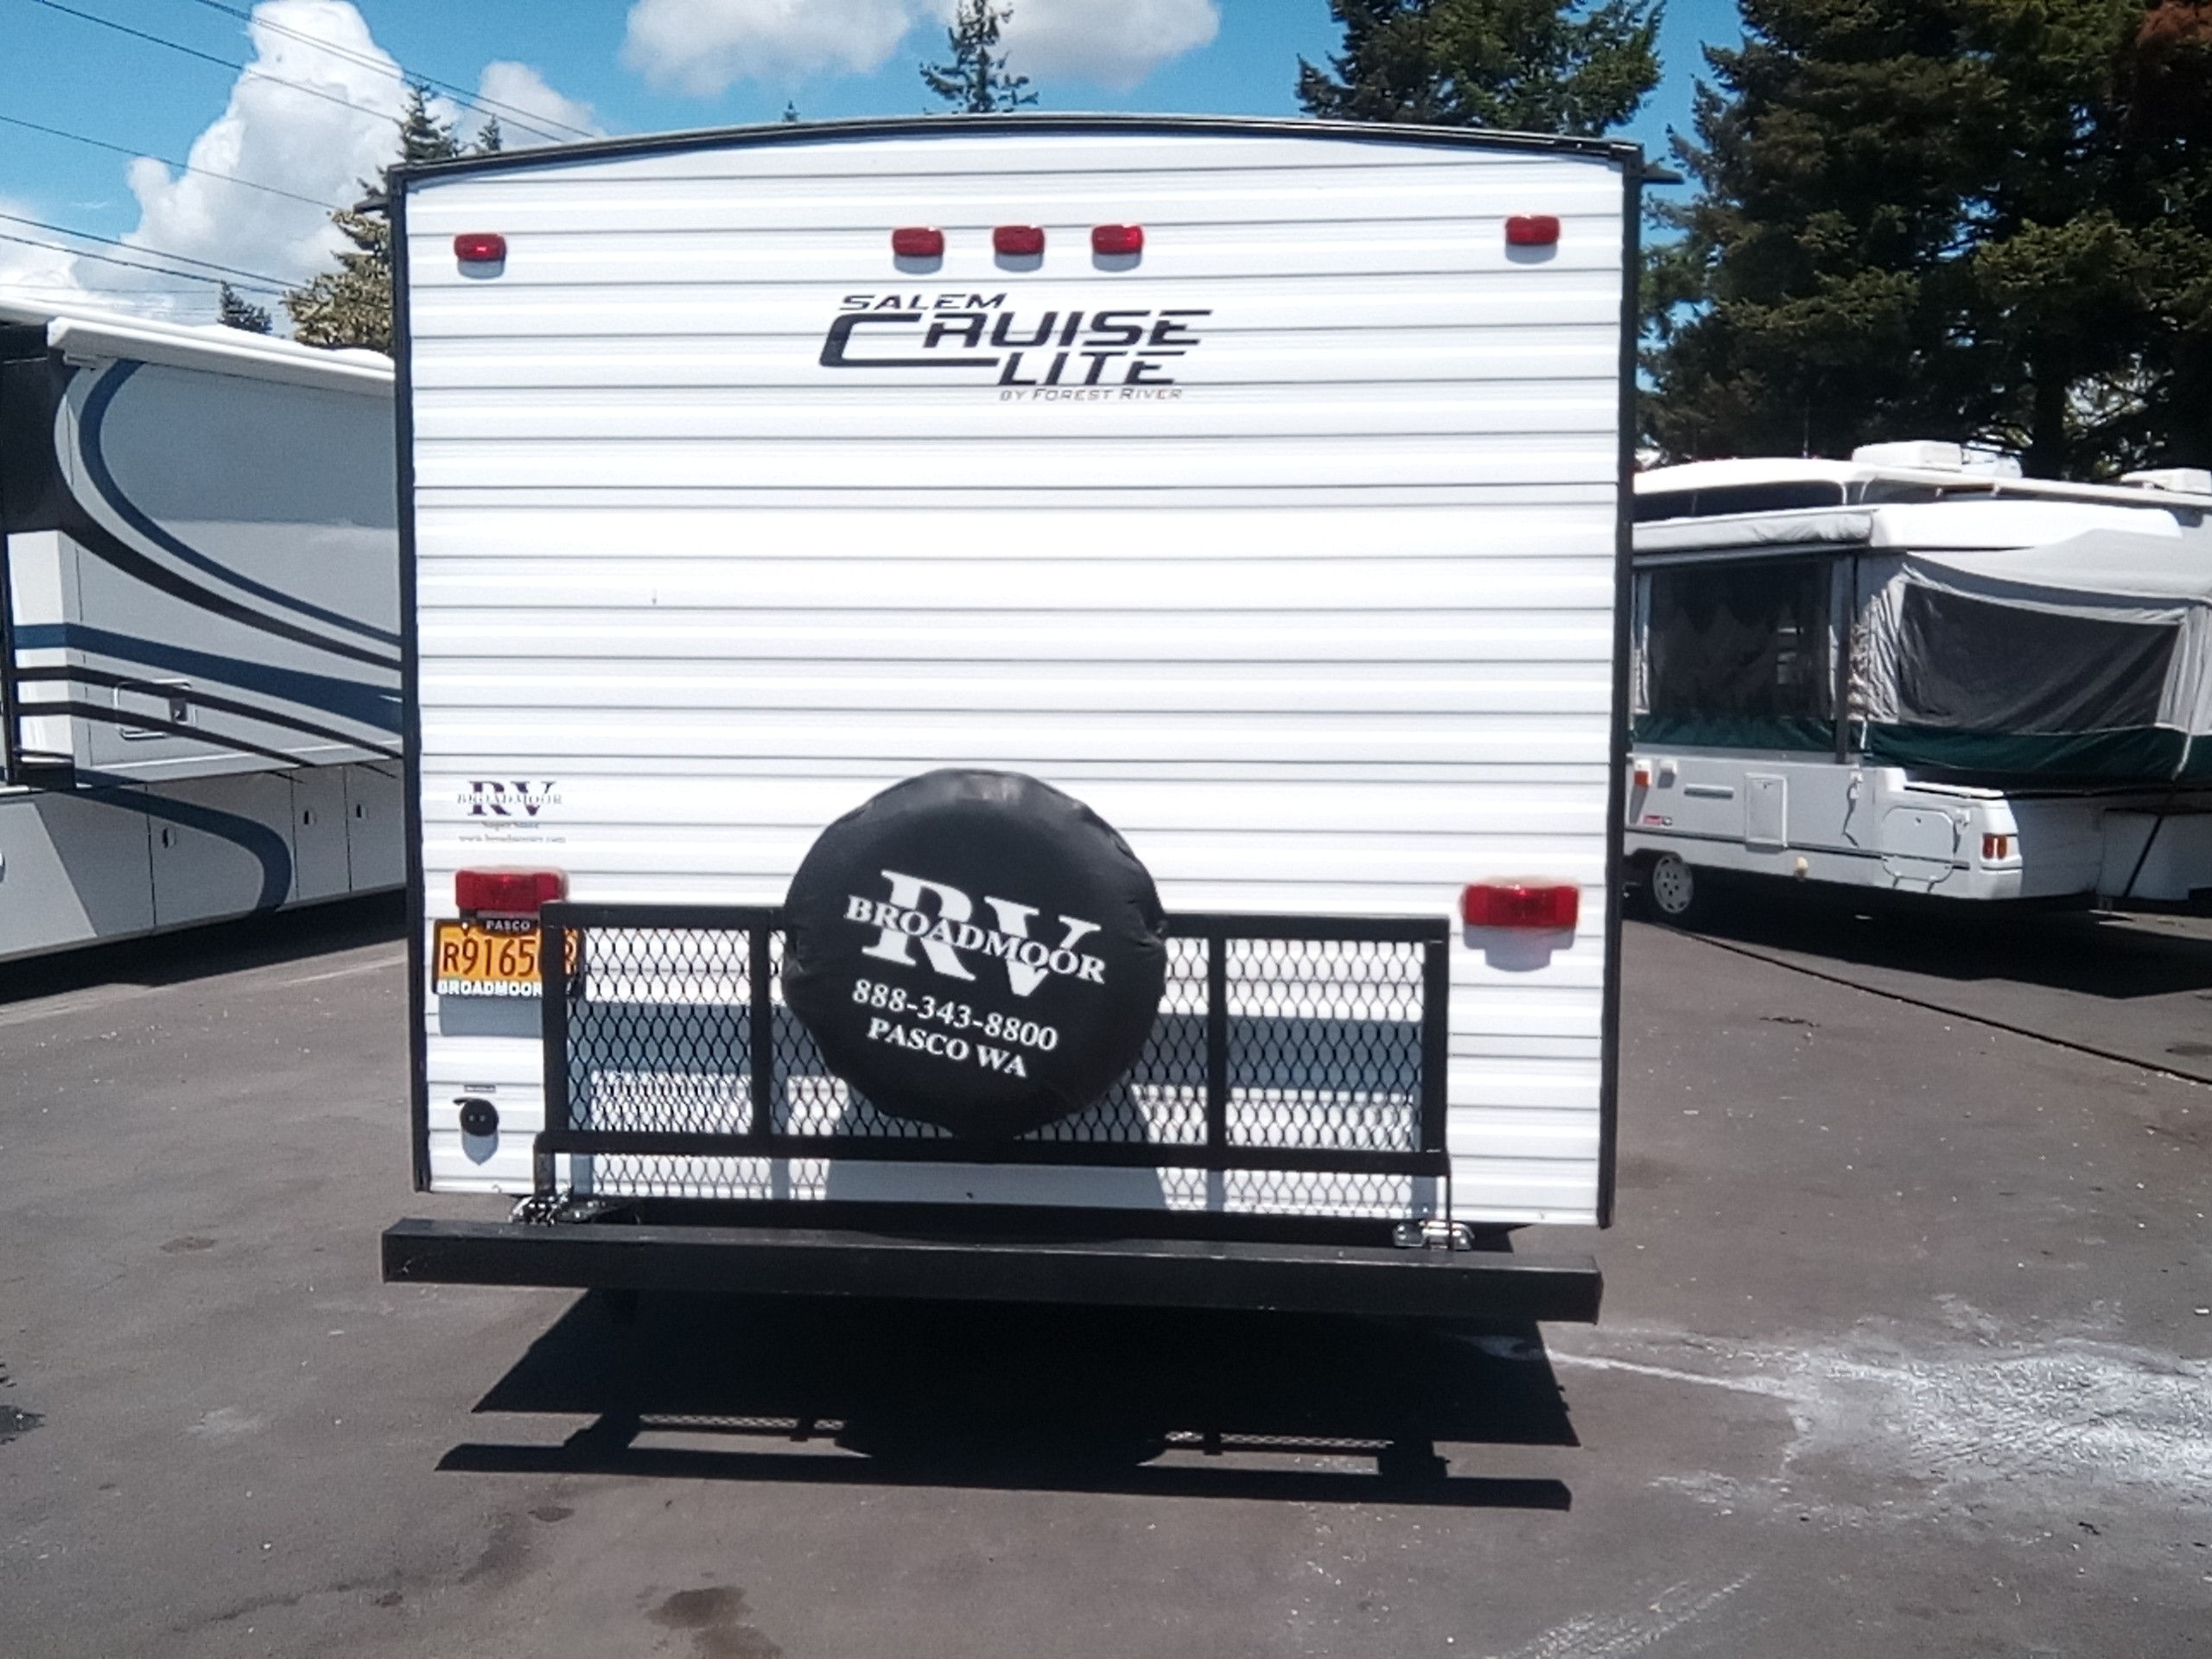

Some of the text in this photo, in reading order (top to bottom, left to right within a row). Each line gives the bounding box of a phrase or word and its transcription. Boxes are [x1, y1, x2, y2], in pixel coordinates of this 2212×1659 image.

[839, 293, 1007, 311] SALEM
[818, 308, 1213, 368] CRUISE
[997, 350, 1187, 386] LITE
[999, 387, 1183, 402] BY FOREST RIVER
[467, 780, 557, 817] RV
[486, 919, 531, 931] PASCO
[843, 894, 1106, 985] BROADMOOR
[861, 869, 1102, 997] RV
[852, 978, 1058, 1052] 888-343-8800
[867, 1017, 1027, 1078] PASCO WA
